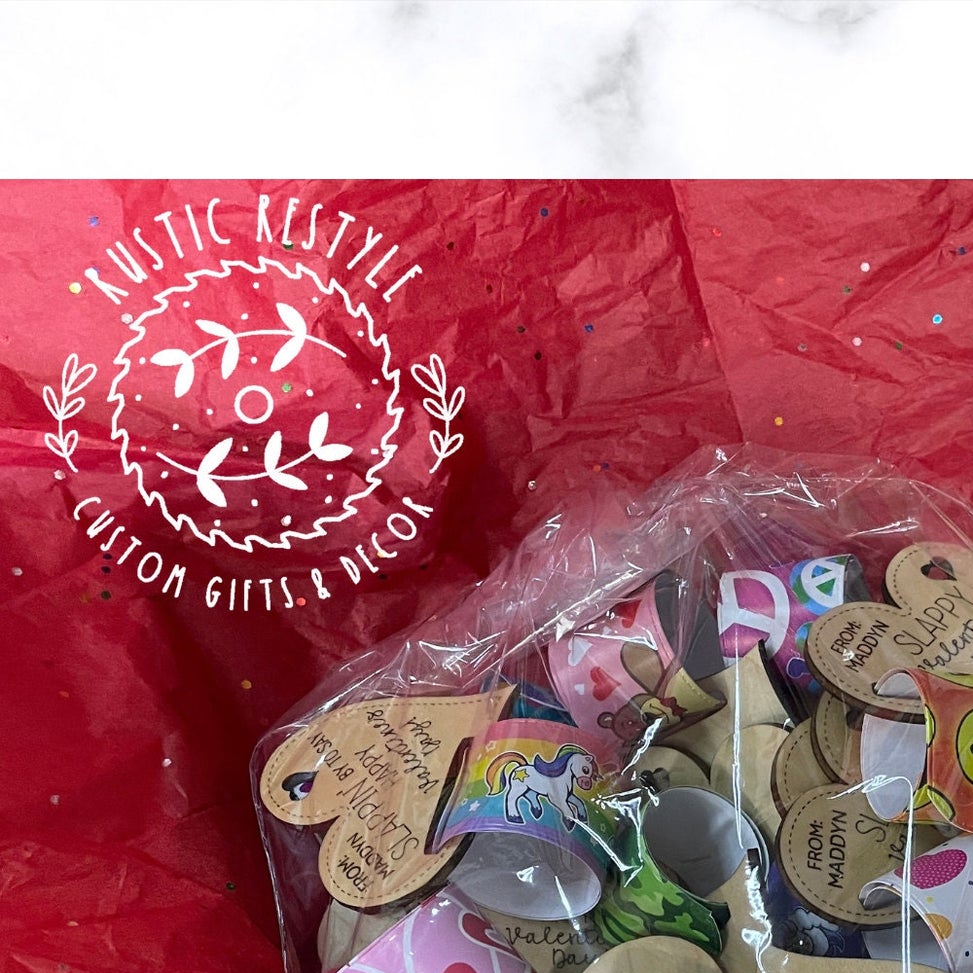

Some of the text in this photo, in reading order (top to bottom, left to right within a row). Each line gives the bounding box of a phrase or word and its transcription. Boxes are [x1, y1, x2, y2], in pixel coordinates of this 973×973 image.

[844, 619, 890, 673] MADDYN
[307, 731, 332, 754] SAY
[323, 748, 342, 768] TO
[332, 762, 355, 782] BY
[354, 744, 400, 786] HAPPY
[348, 832, 395, 881] MADDYN
[807, 819, 824, 872] FROM:
[827, 809, 847, 889] MADDYN
[505, 926, 607, 946] Valenti
